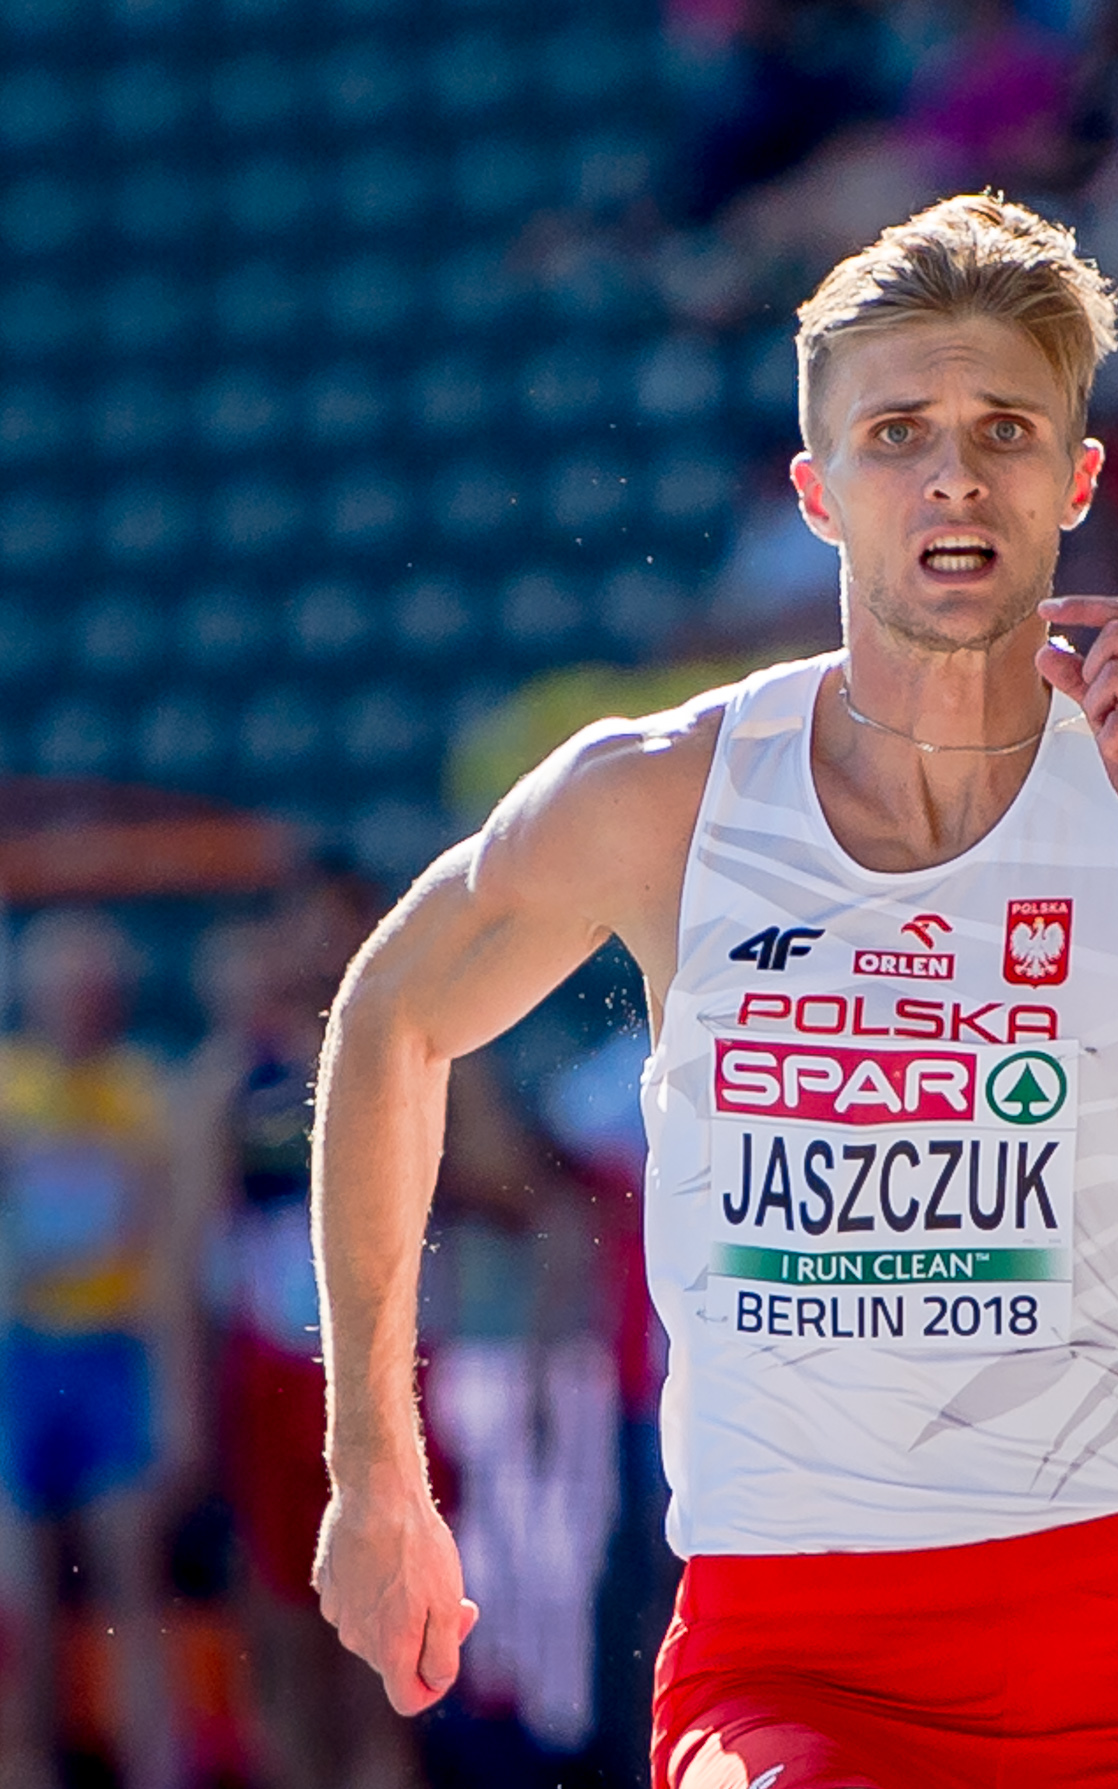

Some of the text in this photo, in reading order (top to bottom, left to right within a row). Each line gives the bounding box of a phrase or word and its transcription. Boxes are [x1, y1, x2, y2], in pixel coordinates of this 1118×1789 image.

[1011, 902, 1069, 914] POLSKA
[729, 926, 825, 970] 4F
[858, 954, 949, 977] ORLEN
[738, 993, 1058, 1043] POLSKA
[721, 1051, 968, 1113] SPAR
[723, 1133, 1058, 1235] JASZCZUK
[782, 1255, 789, 1280] I
[797, 1257, 864, 1280] RUN
[737, 1291, 1038, 1338] BERLIN 2018
